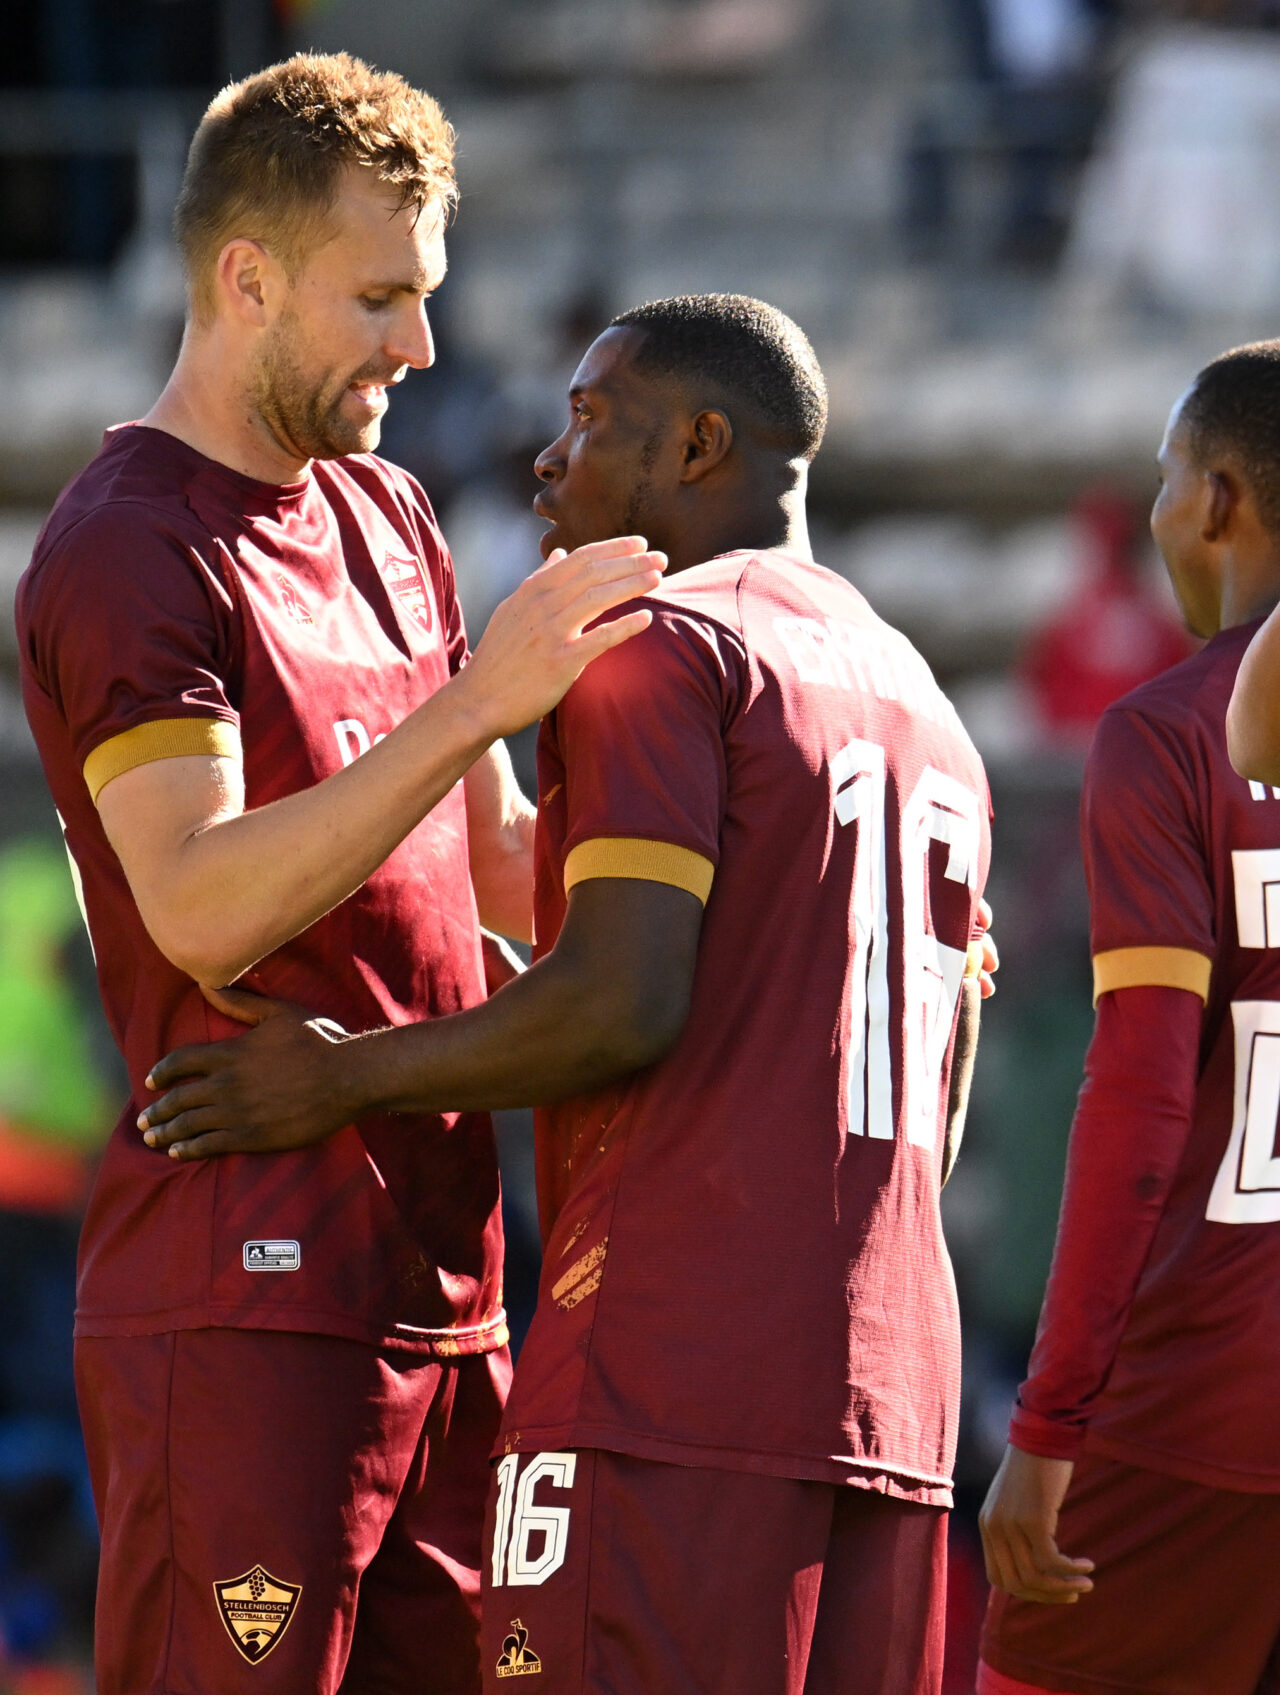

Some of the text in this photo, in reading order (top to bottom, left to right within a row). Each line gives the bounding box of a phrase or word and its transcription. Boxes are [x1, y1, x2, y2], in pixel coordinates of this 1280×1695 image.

[829, 737, 979, 1151] 16
[491, 1452, 577, 1587] 16
[223, 1601, 290, 1612] STELLENBOSCH
[230, 1612, 263, 1620] FOOTBALL
[516, 1662, 541, 1673] SPORTIF
